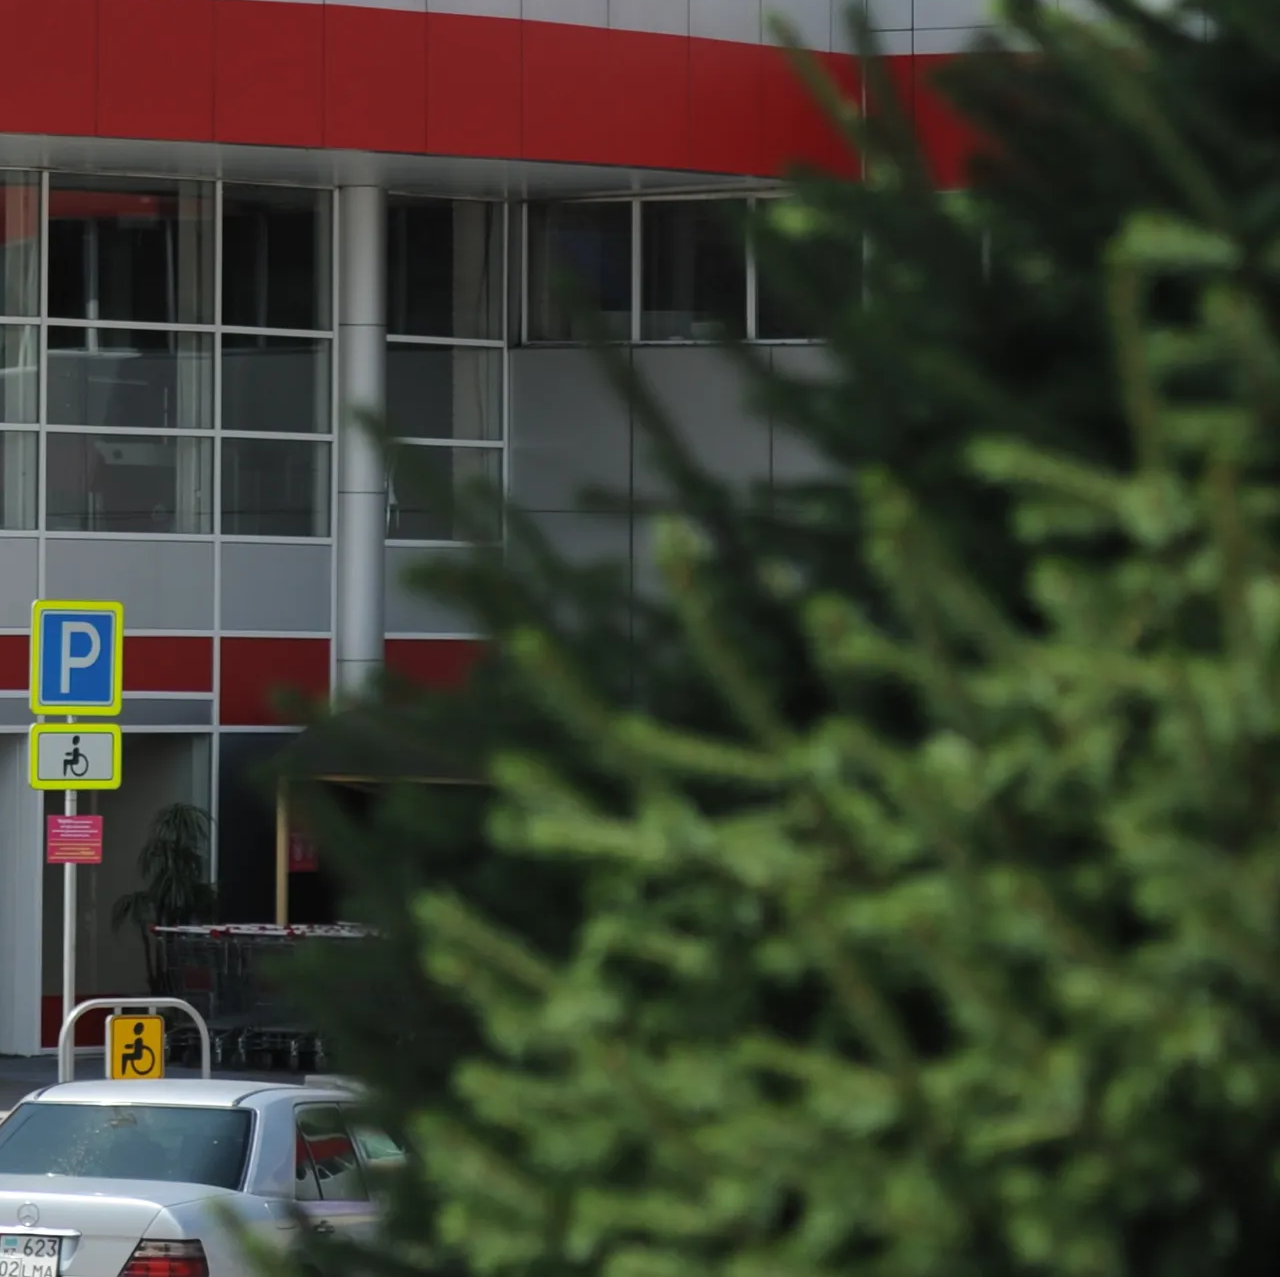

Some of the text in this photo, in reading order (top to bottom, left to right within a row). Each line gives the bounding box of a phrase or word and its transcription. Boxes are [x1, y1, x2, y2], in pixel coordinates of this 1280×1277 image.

[62, 622, 100, 692] P
[23, 1237, 57, 1257] 623
[22, 1264, 53, 1277] LMA
